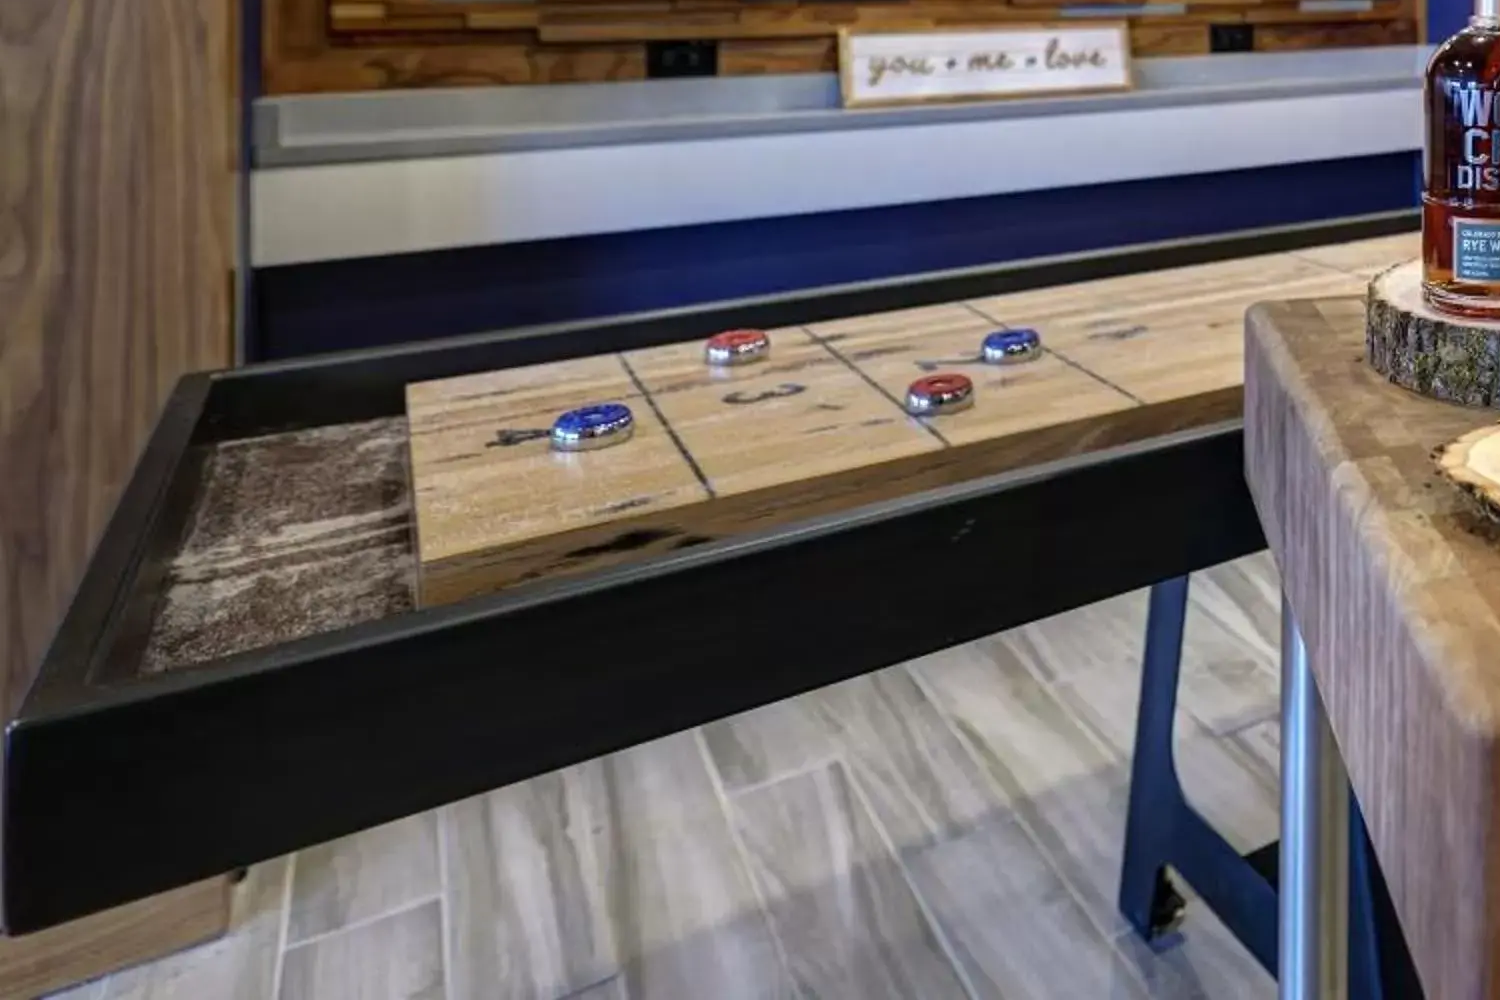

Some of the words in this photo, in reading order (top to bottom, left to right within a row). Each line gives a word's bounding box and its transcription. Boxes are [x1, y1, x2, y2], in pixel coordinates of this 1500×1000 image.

[868, 55, 935, 88] you
[967, 51, 1015, 72] me
[1044, 37, 1108, 71] love
[1463, 239, 1487, 253] RYE
